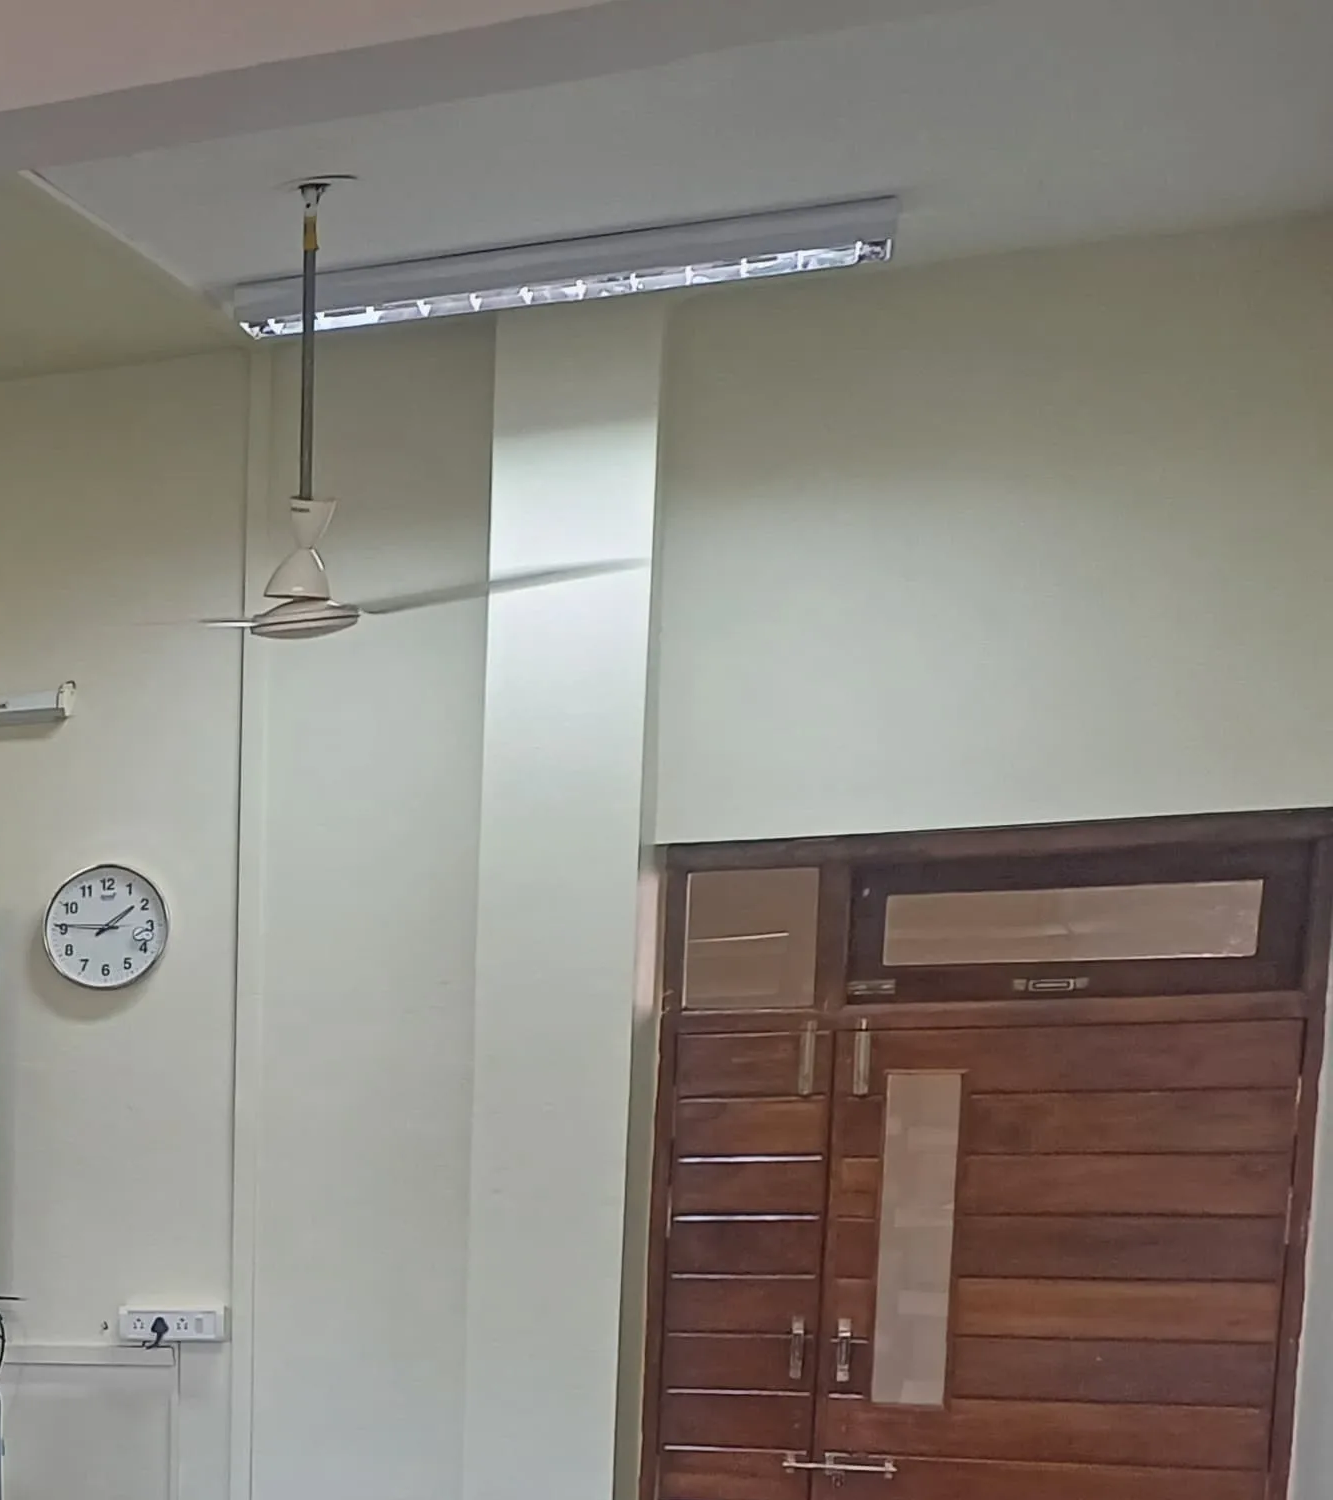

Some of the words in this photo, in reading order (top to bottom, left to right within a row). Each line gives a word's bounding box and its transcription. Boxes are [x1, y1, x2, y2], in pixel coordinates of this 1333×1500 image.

[100, 878, 116, 891] 12
[126, 883, 133, 895] 1
[80, 885, 92, 898] 11
[63, 902, 78, 914] 10
[140, 898, 149, 911] 2
[59, 923, 68, 935] 9
[146, 920, 154, 932] 3
[65, 944, 73, 956] 8
[139, 940, 148, 954] 4
[80, 959, 89, 972] 7
[123, 957, 132, 970] 5
[101, 964, 110, 976] 6
